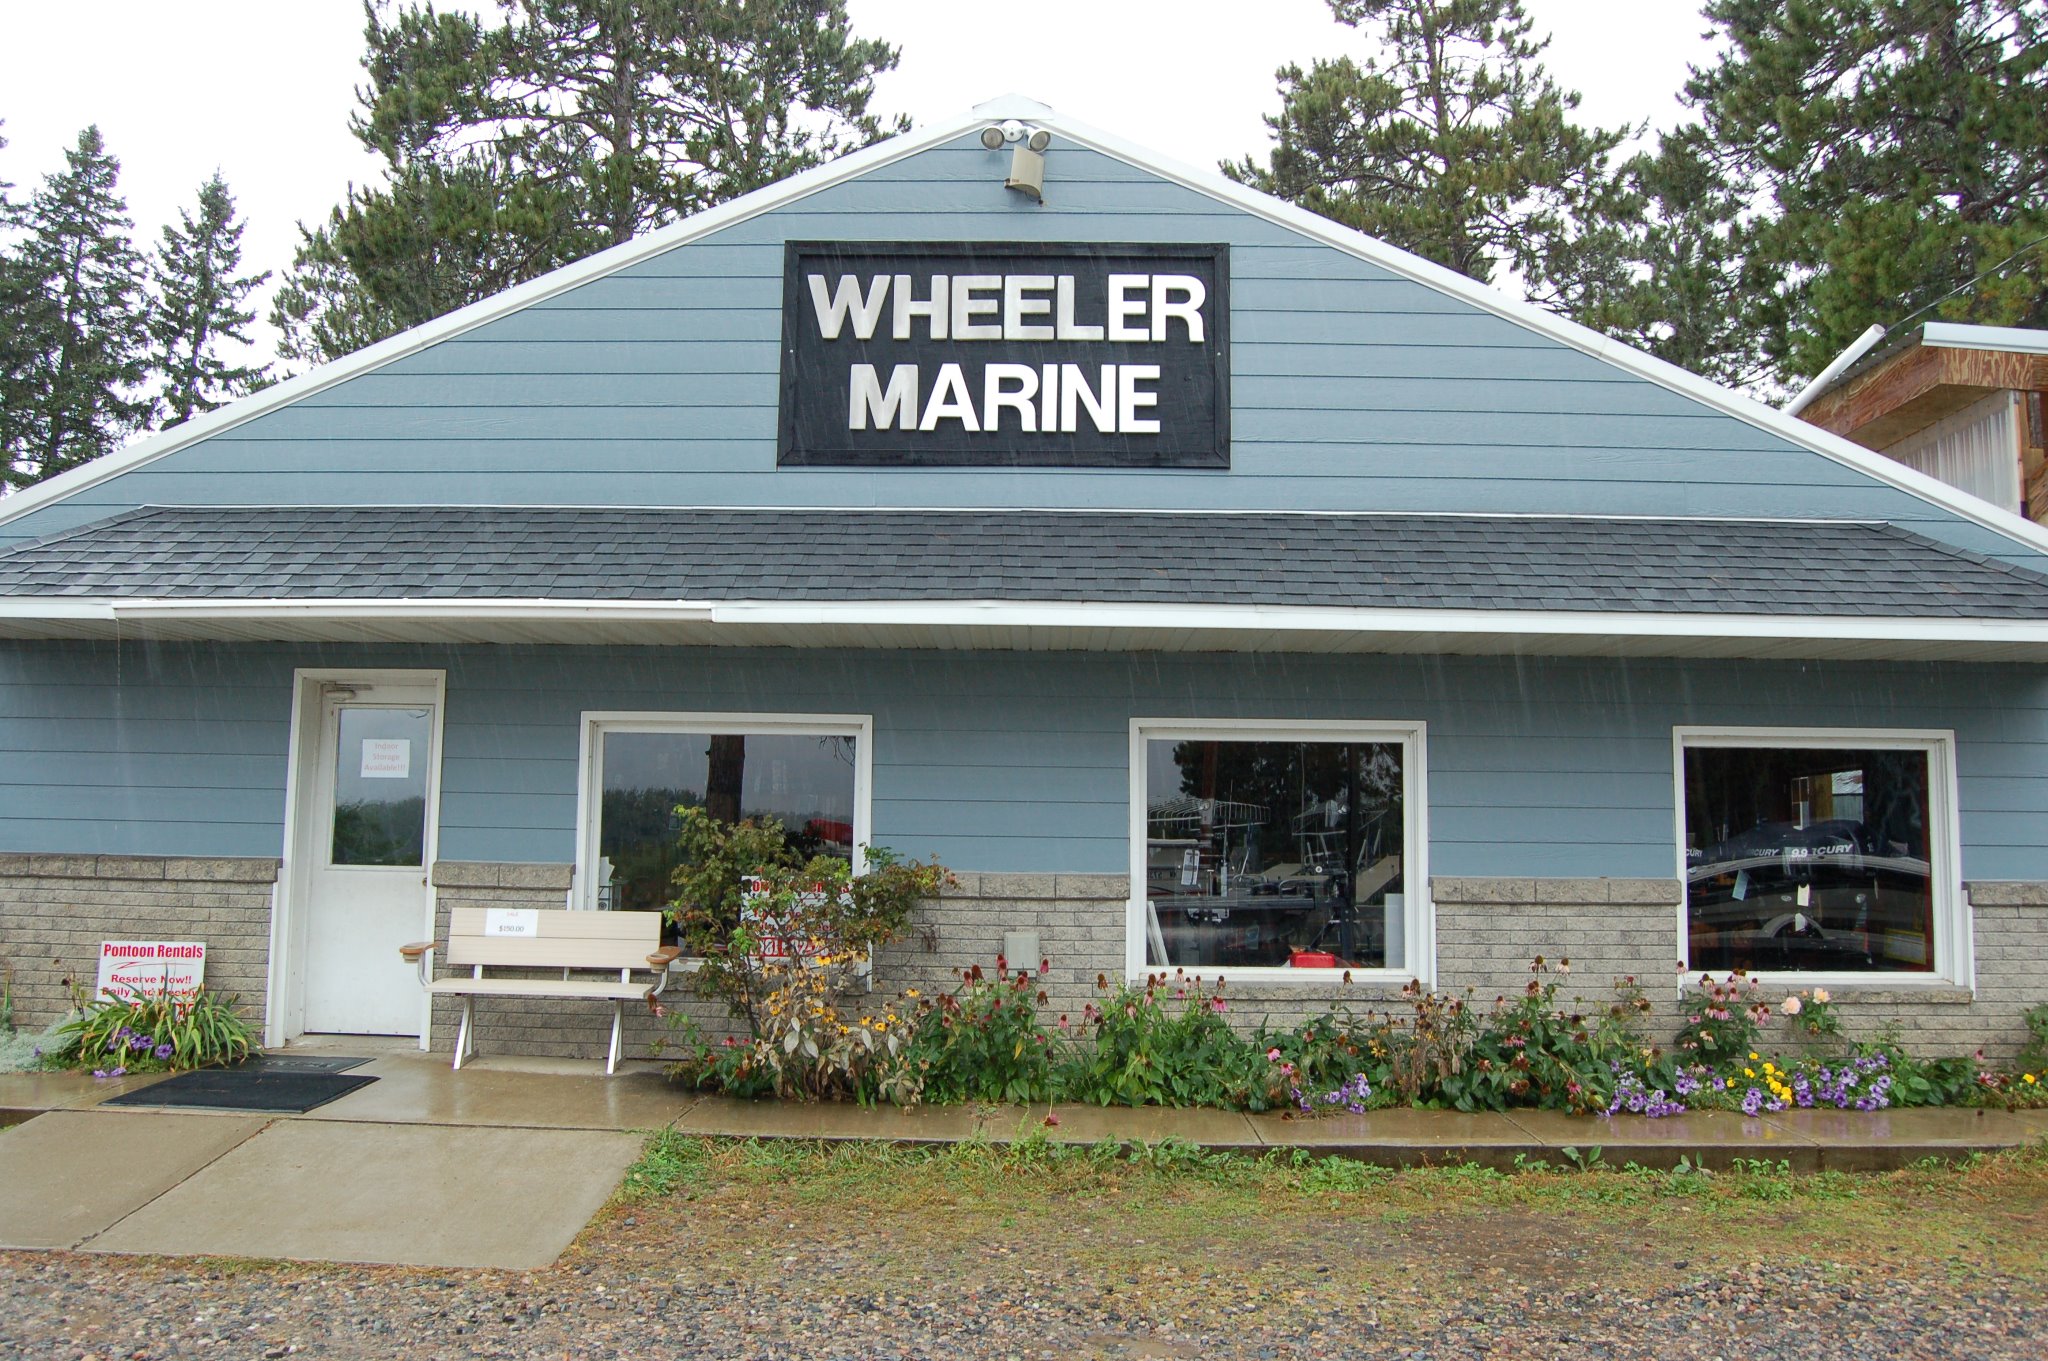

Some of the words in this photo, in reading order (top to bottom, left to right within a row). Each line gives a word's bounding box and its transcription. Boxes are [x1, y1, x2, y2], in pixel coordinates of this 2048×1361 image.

[807, 274, 1206, 342] WHEELER
[849, 363, 1161, 433] MARINE
[1791, 848, 1808, 858] 9.9
[104, 944, 154, 957] Pontoon
[158, 945, 203, 958] Rentals
[111, 975, 156, 983] Reserve
